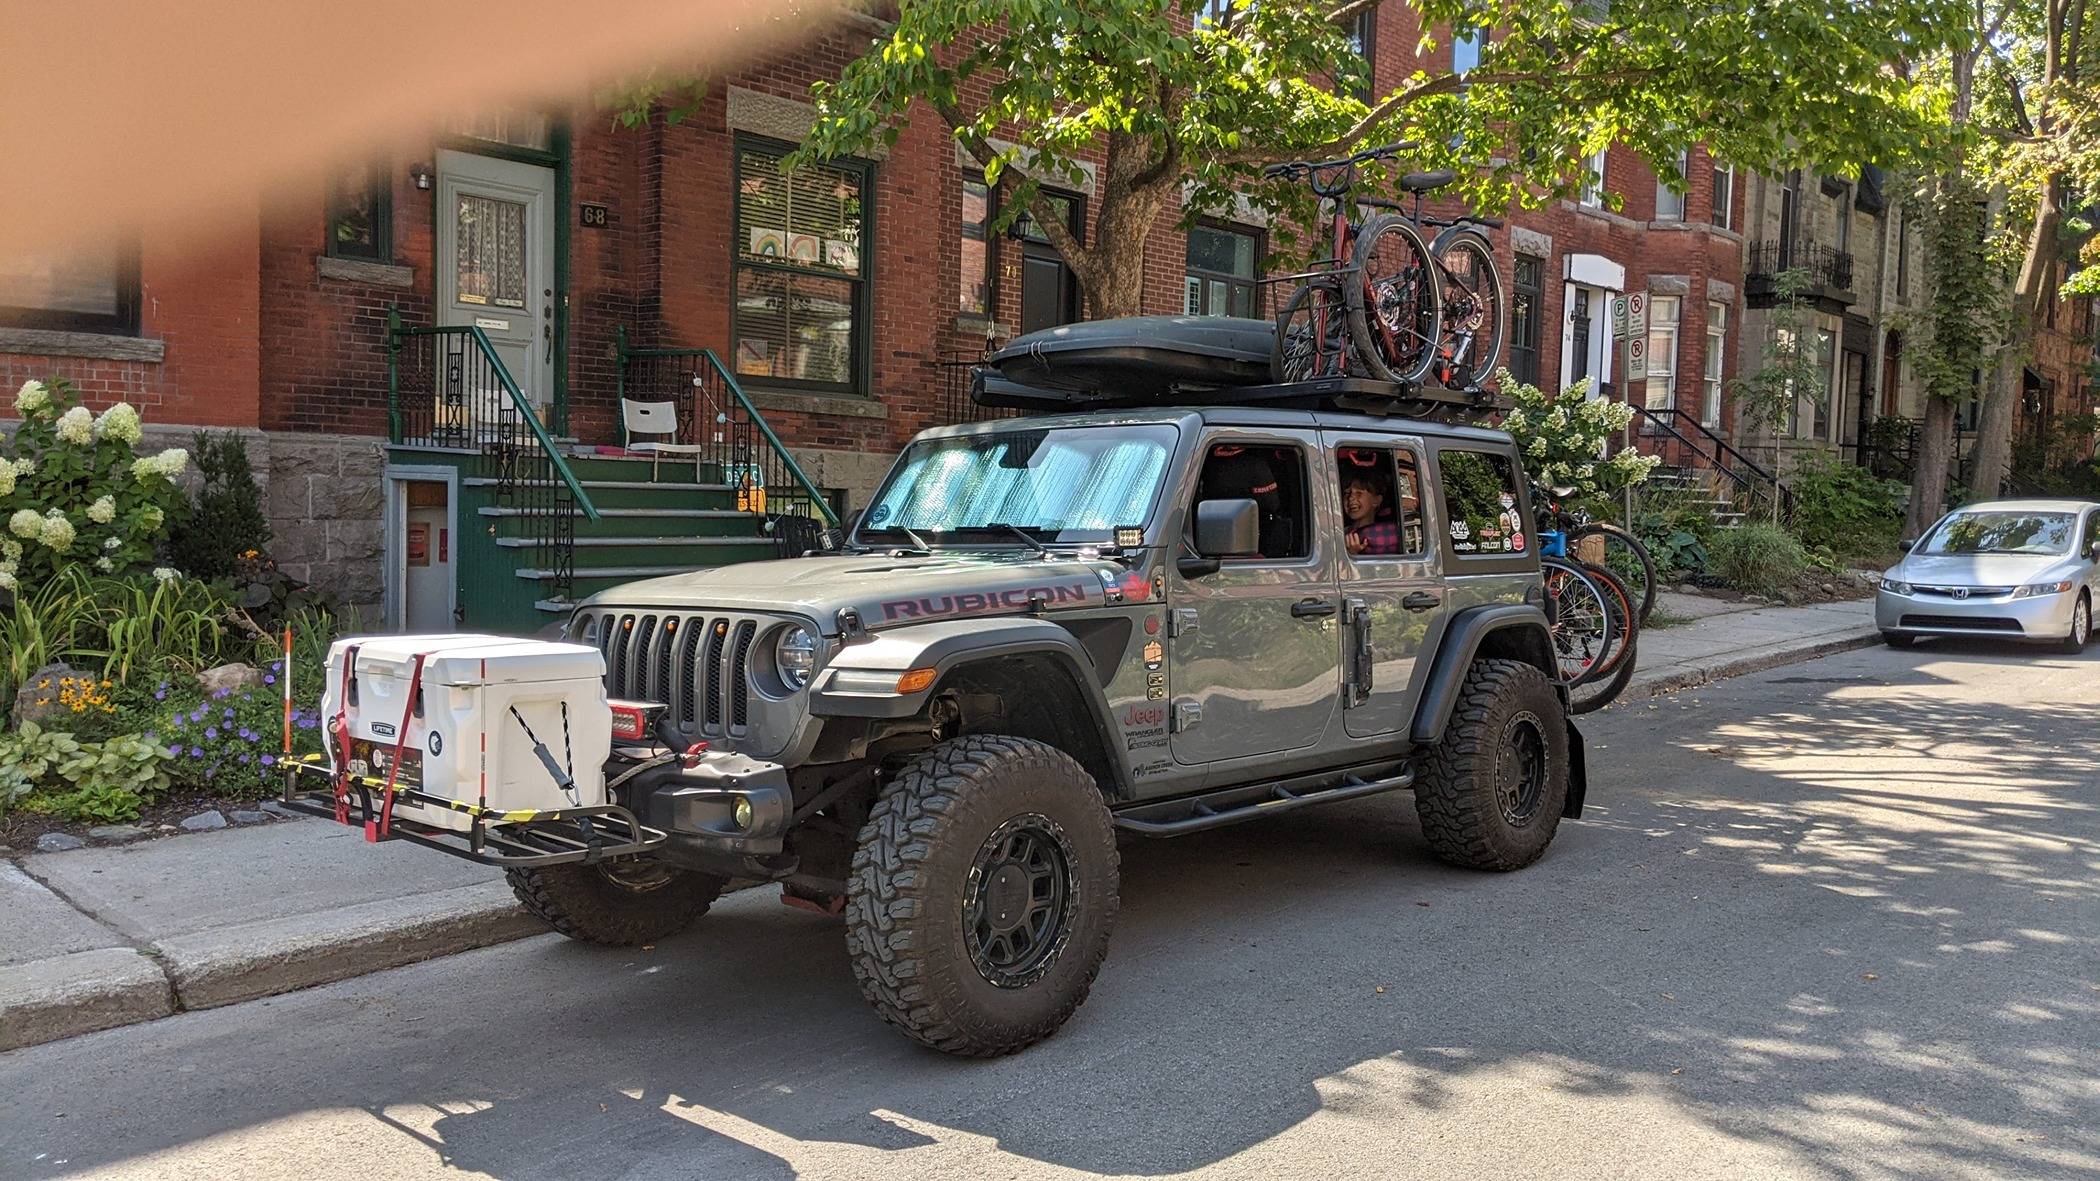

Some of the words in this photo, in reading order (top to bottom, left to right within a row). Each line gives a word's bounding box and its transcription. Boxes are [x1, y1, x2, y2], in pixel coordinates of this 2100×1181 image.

[584, 206, 605, 225] 68
[1480, 541, 1500, 549] FALCON
[881, 584, 1086, 621] RUBICON
[1124, 705, 1164, 728] Jeep
[373, 725, 394, 735] LIFETIME
[1125, 728, 1164, 737] WRANGLER
